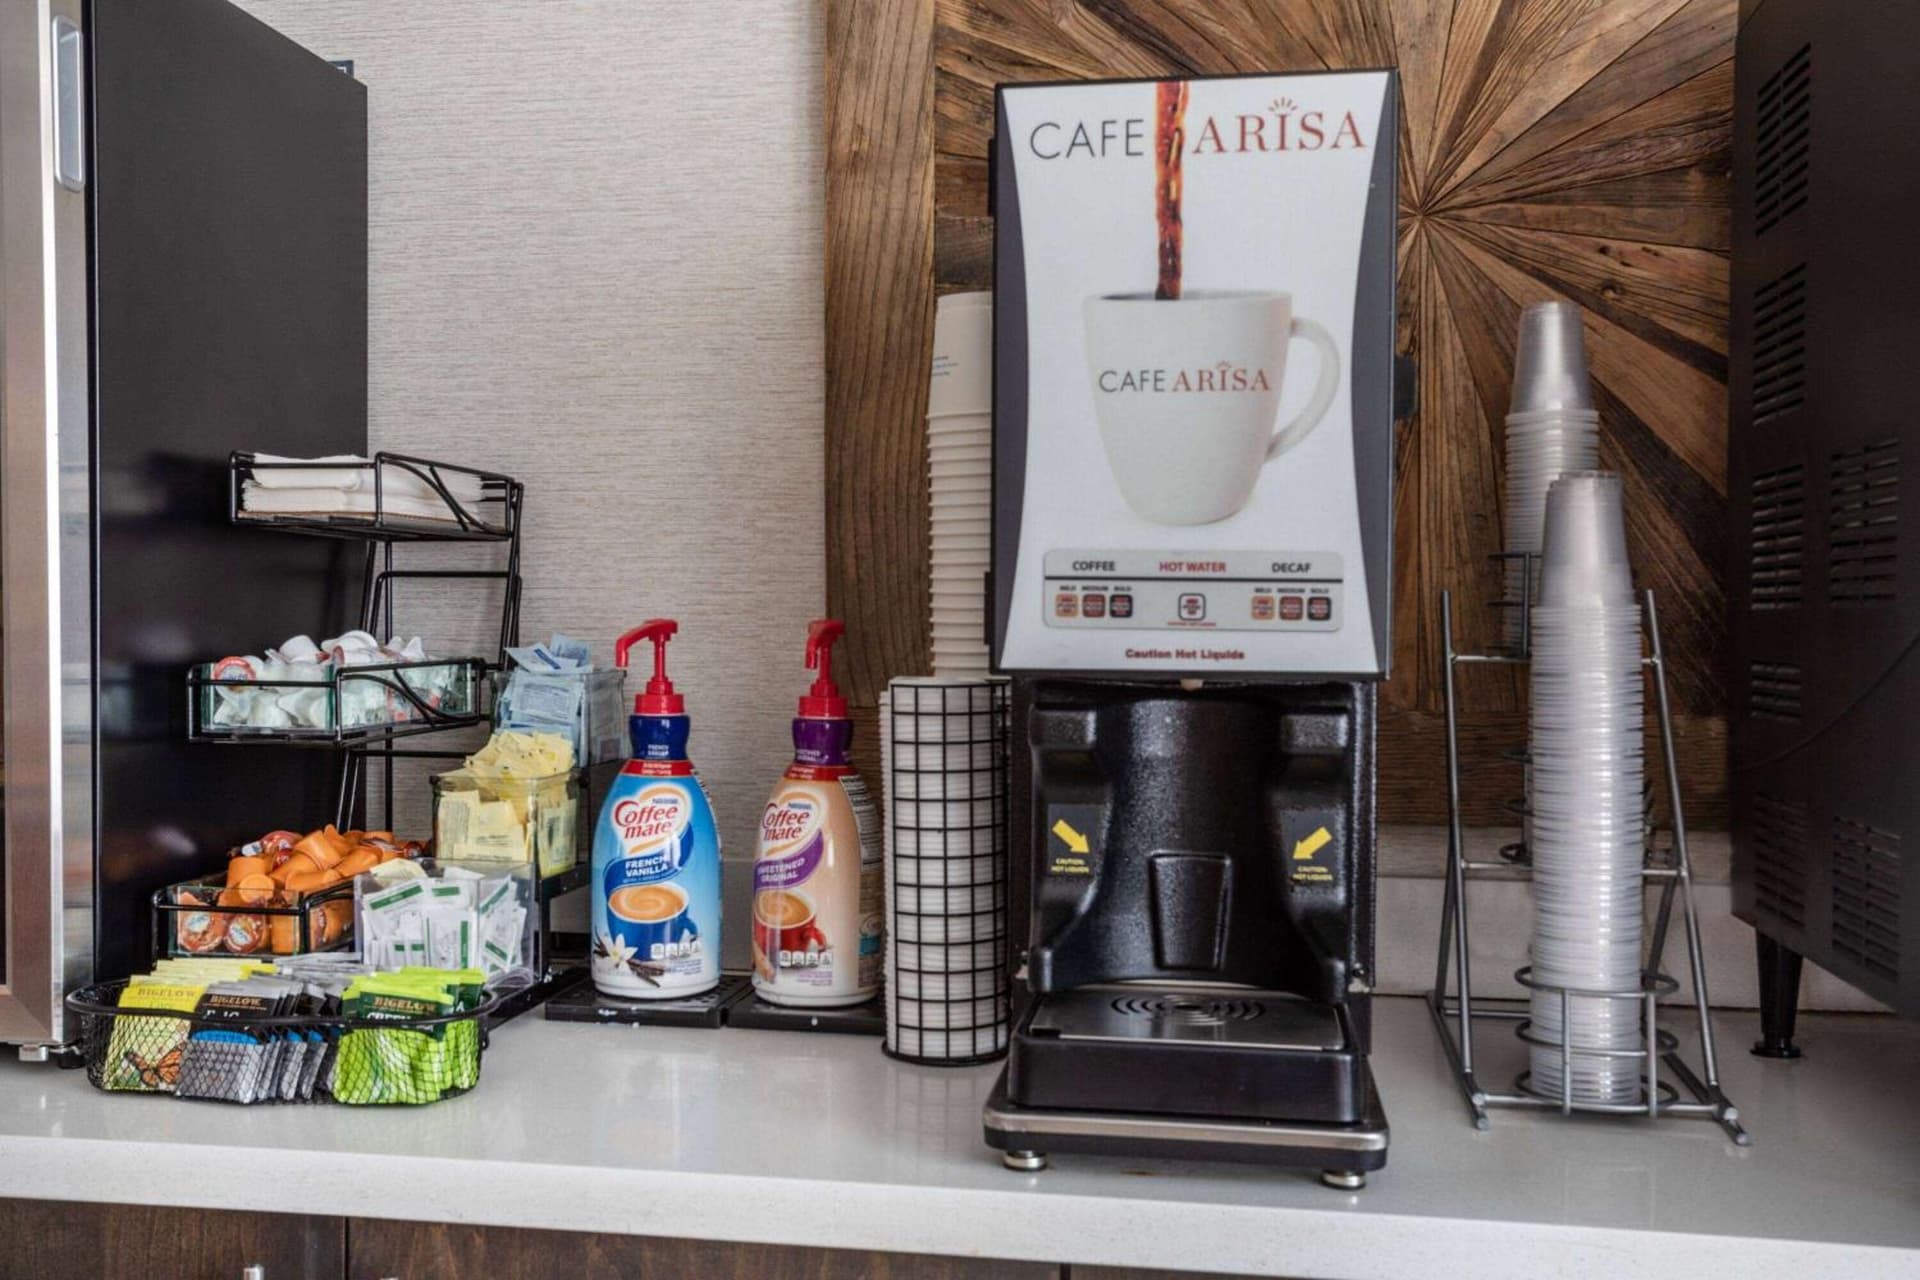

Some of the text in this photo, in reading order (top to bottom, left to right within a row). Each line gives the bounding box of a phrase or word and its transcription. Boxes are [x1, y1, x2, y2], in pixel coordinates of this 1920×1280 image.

[1030, 119, 1144, 160] CAFE
[1099, 370, 1166, 393] CAFE
[1072, 561, 1116, 572] COFFEE
[1159, 562, 1227, 573] HOT WATER
[1271, 562, 1311, 574] DECAF
[1125, 649, 1171, 660] Caution
[1175, 649, 1198, 660] Hot
[614, 800, 679, 828] Coffee
[762, 802, 810, 829] Coffee
[624, 820, 673, 840] mate
[764, 827, 802, 841] mate
[625, 862, 669, 878] VANILLA
[137, 987, 197, 997] BIGELOW
[209, 994, 263, 1007] BIGELOW
[373, 996, 437, 1013] BIGELOW
